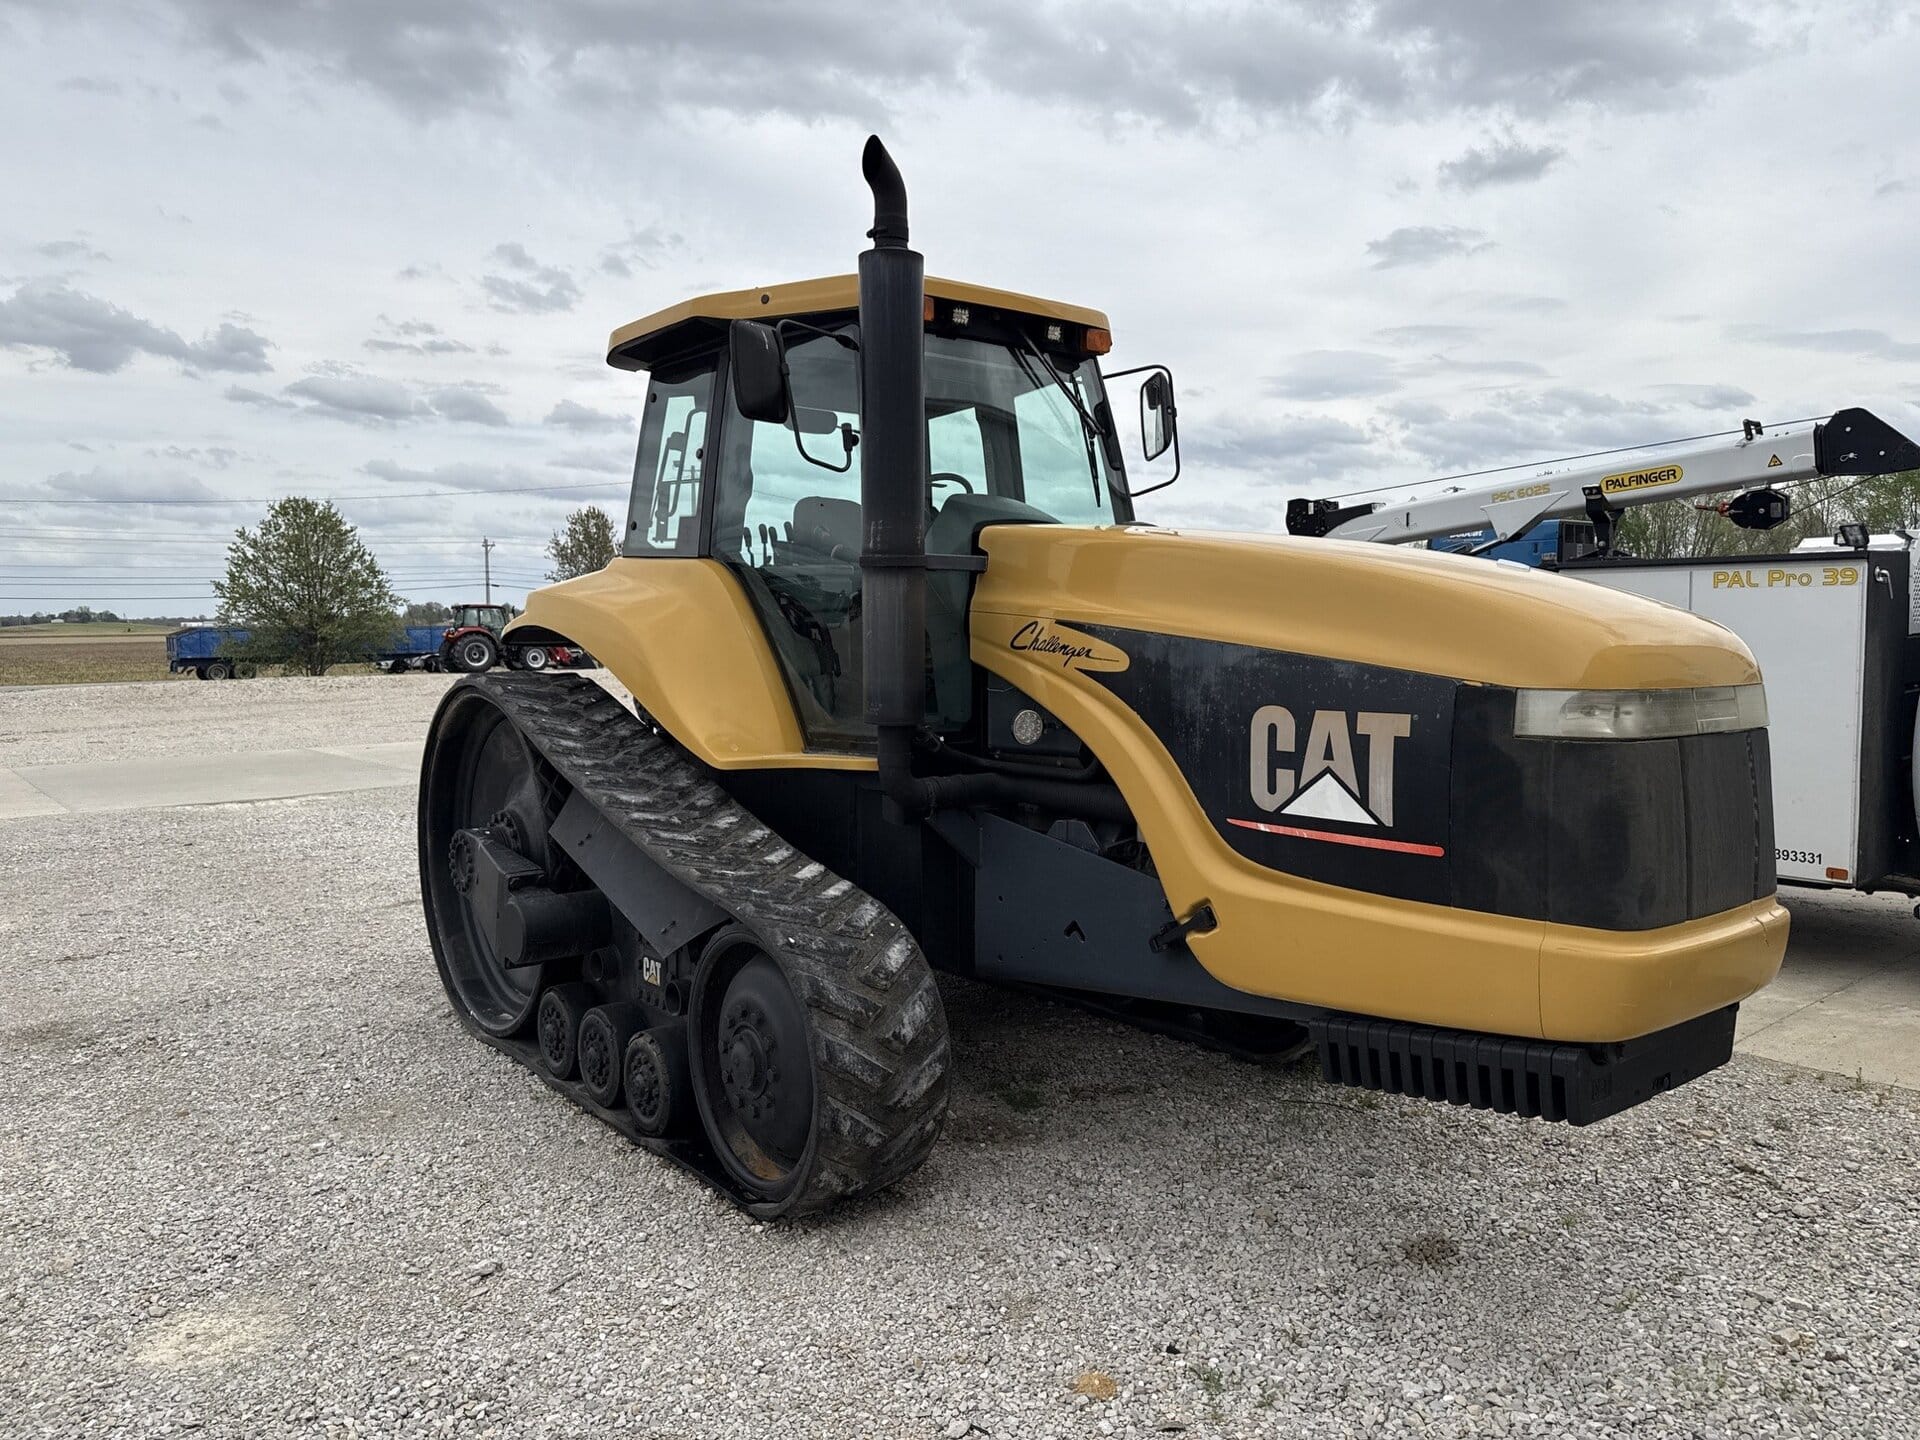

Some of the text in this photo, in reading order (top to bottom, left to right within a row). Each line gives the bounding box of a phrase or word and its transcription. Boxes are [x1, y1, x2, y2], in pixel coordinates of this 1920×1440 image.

[1516, 483, 1550, 498] 6025
[1605, 469, 1677, 491] PALFINGER
[1713, 567, 1859, 588] PAL Pro 39
[1010, 620, 1119, 667] Challenger
[1250, 705, 1412, 828] CAT
[642, 956, 661, 986] CAT
